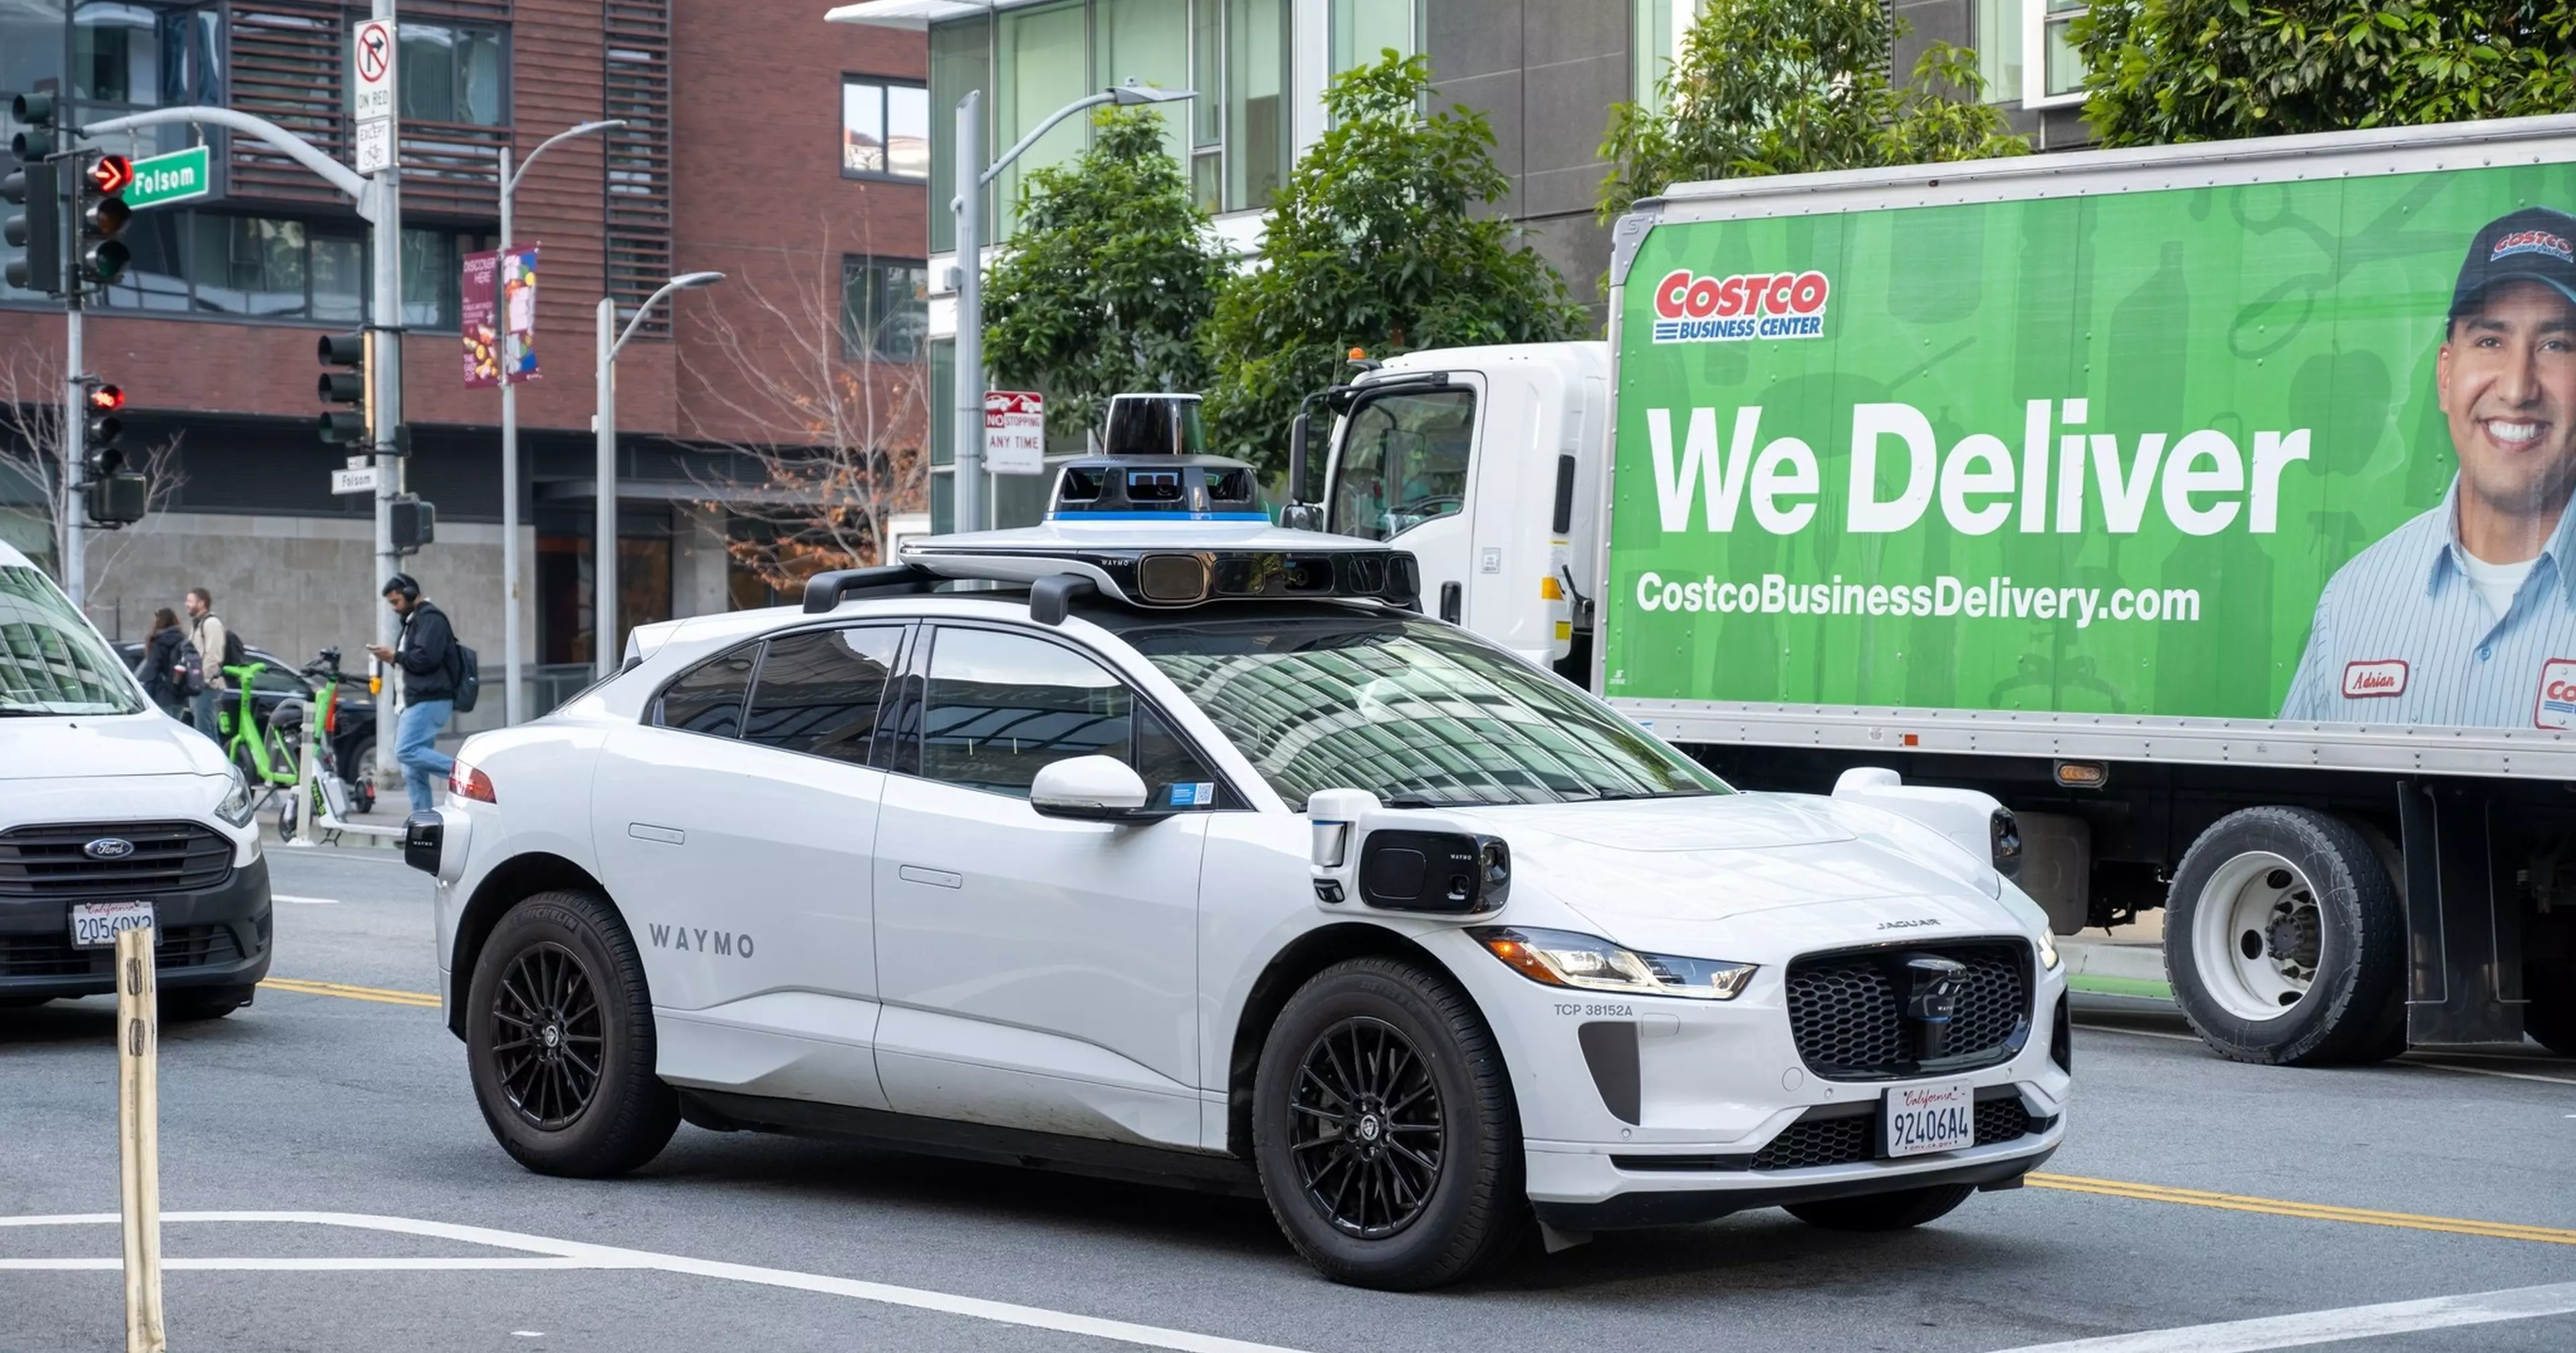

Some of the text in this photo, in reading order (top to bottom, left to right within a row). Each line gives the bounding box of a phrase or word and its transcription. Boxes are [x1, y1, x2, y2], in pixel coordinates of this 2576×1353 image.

[358, 89, 388, 109] ON RED
[135, 166, 195, 197] Folsom
[2494, 231, 2574, 253] COSTCO
[1656, 272, 1827, 319] COSTCO
[1679, 316, 1821, 339] BUSINESS CENTER
[987, 415, 1040, 427] NO STOPPING
[989, 435, 1039, 449] ANY TIME
[1646, 398, 2312, 536] We Deliver
[342, 474, 371, 488] Folsom
[1636, 572, 2200, 629] CostcoBusinessDelivery.com
[2352, 671, 2396, 690] Adrian
[97, 841, 124, 855] Ford
[87, 904, 140, 916] California
[1876, 918, 1941, 930] JAGUAR
[649, 922, 754, 959] WAYMO
[1554, 1004, 1633, 1016] TCP 38152A
[1905, 1088, 1957, 1110] California
[1894, 1106, 1968, 1146] 92406A4
[1909, 1141, 1953, 1150] dmv.ca.gov
